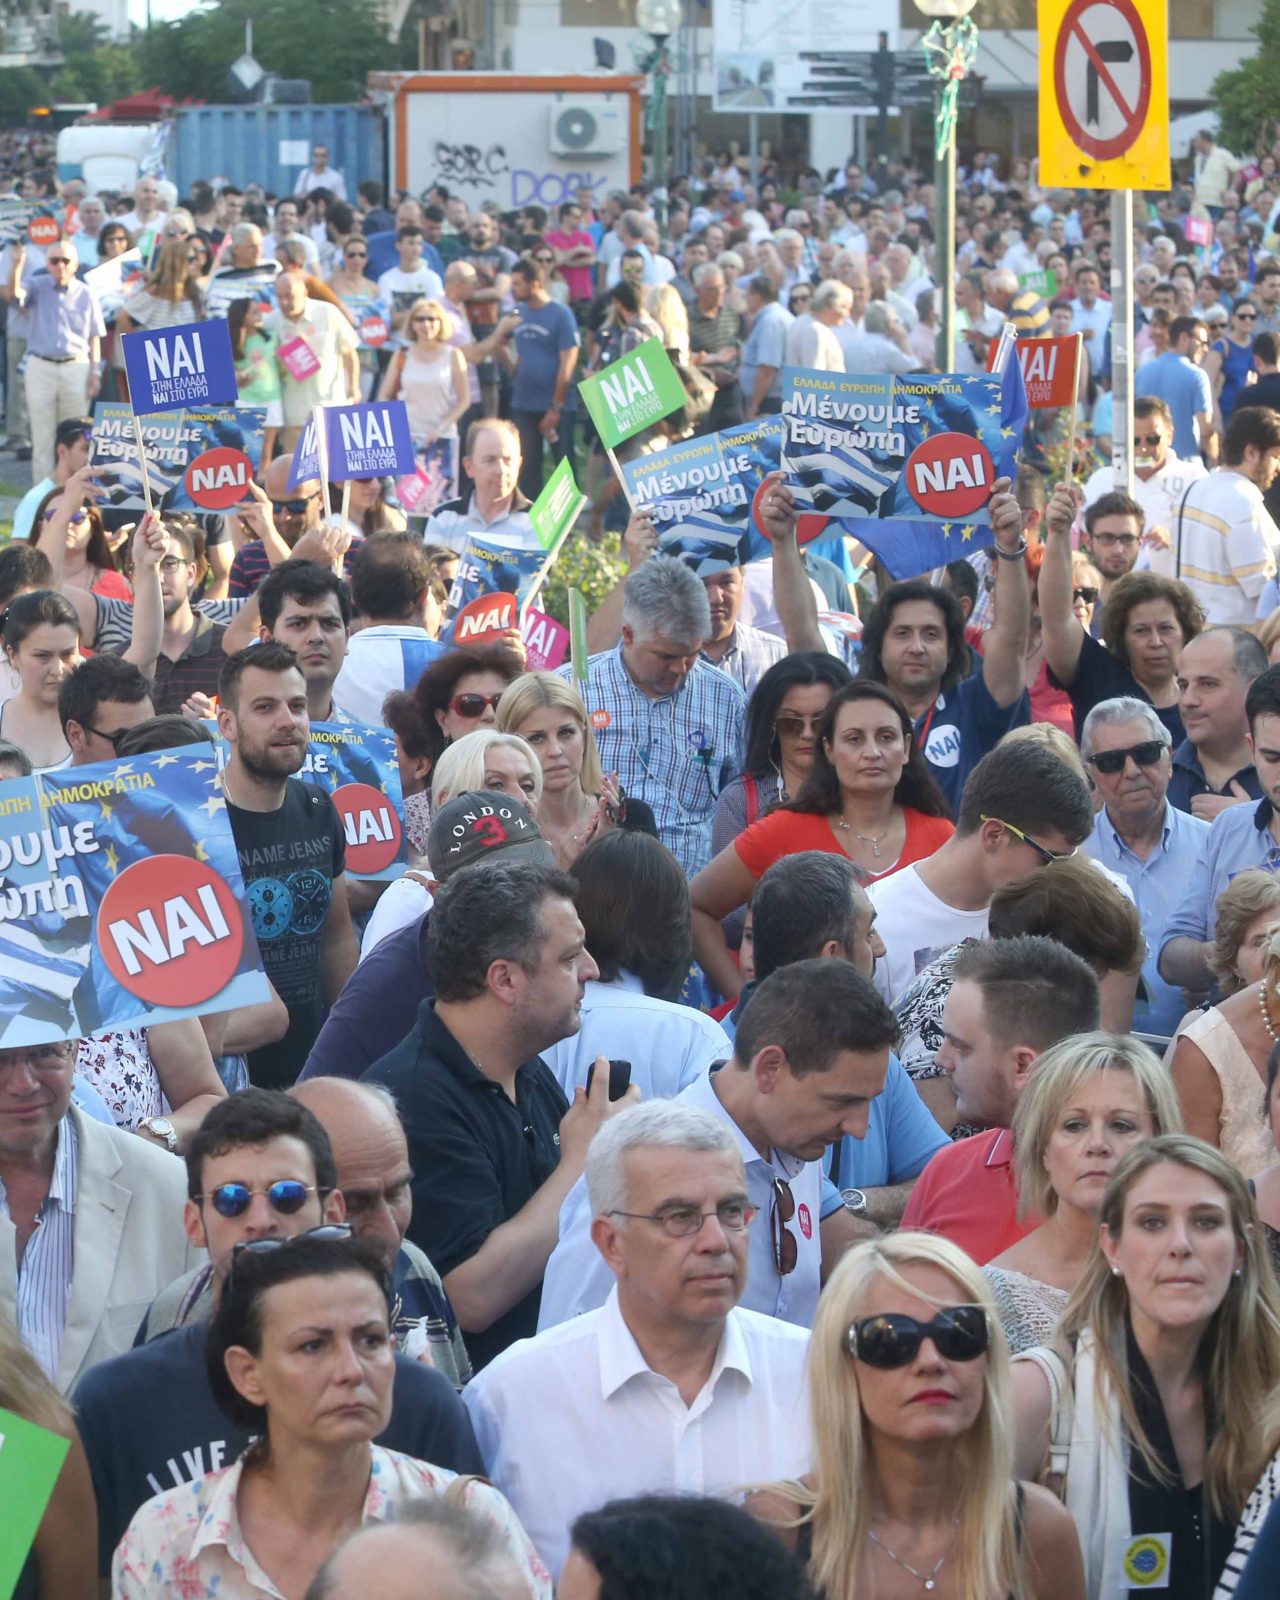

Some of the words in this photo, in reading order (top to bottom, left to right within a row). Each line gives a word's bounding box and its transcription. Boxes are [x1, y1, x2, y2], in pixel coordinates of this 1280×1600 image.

[30, 223, 59, 238] ΝΑΙ
[144, 332, 205, 381] ΝΑΙ
[151, 379, 172, 394] ΣΤΗΝ
[175, 375, 207, 390] ΕΛΛΑΔΑ
[152, 392, 169, 405] ΝΑΙ
[170, 389, 186, 402] ΣΤΟ
[187, 385, 209, 399] ΕΥΡΩ
[600, 356, 654, 414] ΝΑΙ
[793, 377, 836, 391] ΕΛΛΑΔΑ
[840, 382, 885, 394] ΕΥΡΩΠΗ
[890, 384, 963, 396] ΔΗΜΟΚΡΑΤΙΑ
[791, 391, 921, 429] Μένουμε
[339, 409, 394, 451] ΝΑΙ
[790, 419, 906, 457] Ευρώπη
[346, 450, 366, 460] ΣΤΗΝ
[367, 448, 396, 459] ΕΛΛΑΔΑ
[347, 460, 362, 472] ΝΑΙ
[364, 459, 377, 471] ΣΤΟ
[380, 458, 398, 469] ΕΥΡΩ
[633, 459, 670, 478] ΕΛΛΑΔΑ
[673, 445, 713, 464] ΕΥΡΩΠΗ
[718, 426, 781, 450] ΔΗΜΟΚΡΑΤΙΑ
[192, 463, 245, 492] ΝΑΙ
[636, 454, 752, 504] Μένουμε
[913, 454, 986, 495] ΝΑΙ
[460, 604, 511, 638] ΝΑΙ
[310, 732, 363, 745] ΜΟΚΡΑΤΙΑ
[928, 731, 960, 760] ΝΑΙ
[39, 772, 156, 808] ΔΗΜΟΚΡΑΤΙΑ
[450, 806, 528, 853] LONDON
[473, 815, 508, 847] 3
[288, 836, 332, 859] JEANS
[109, 884, 231, 976] ΝΑΙ
